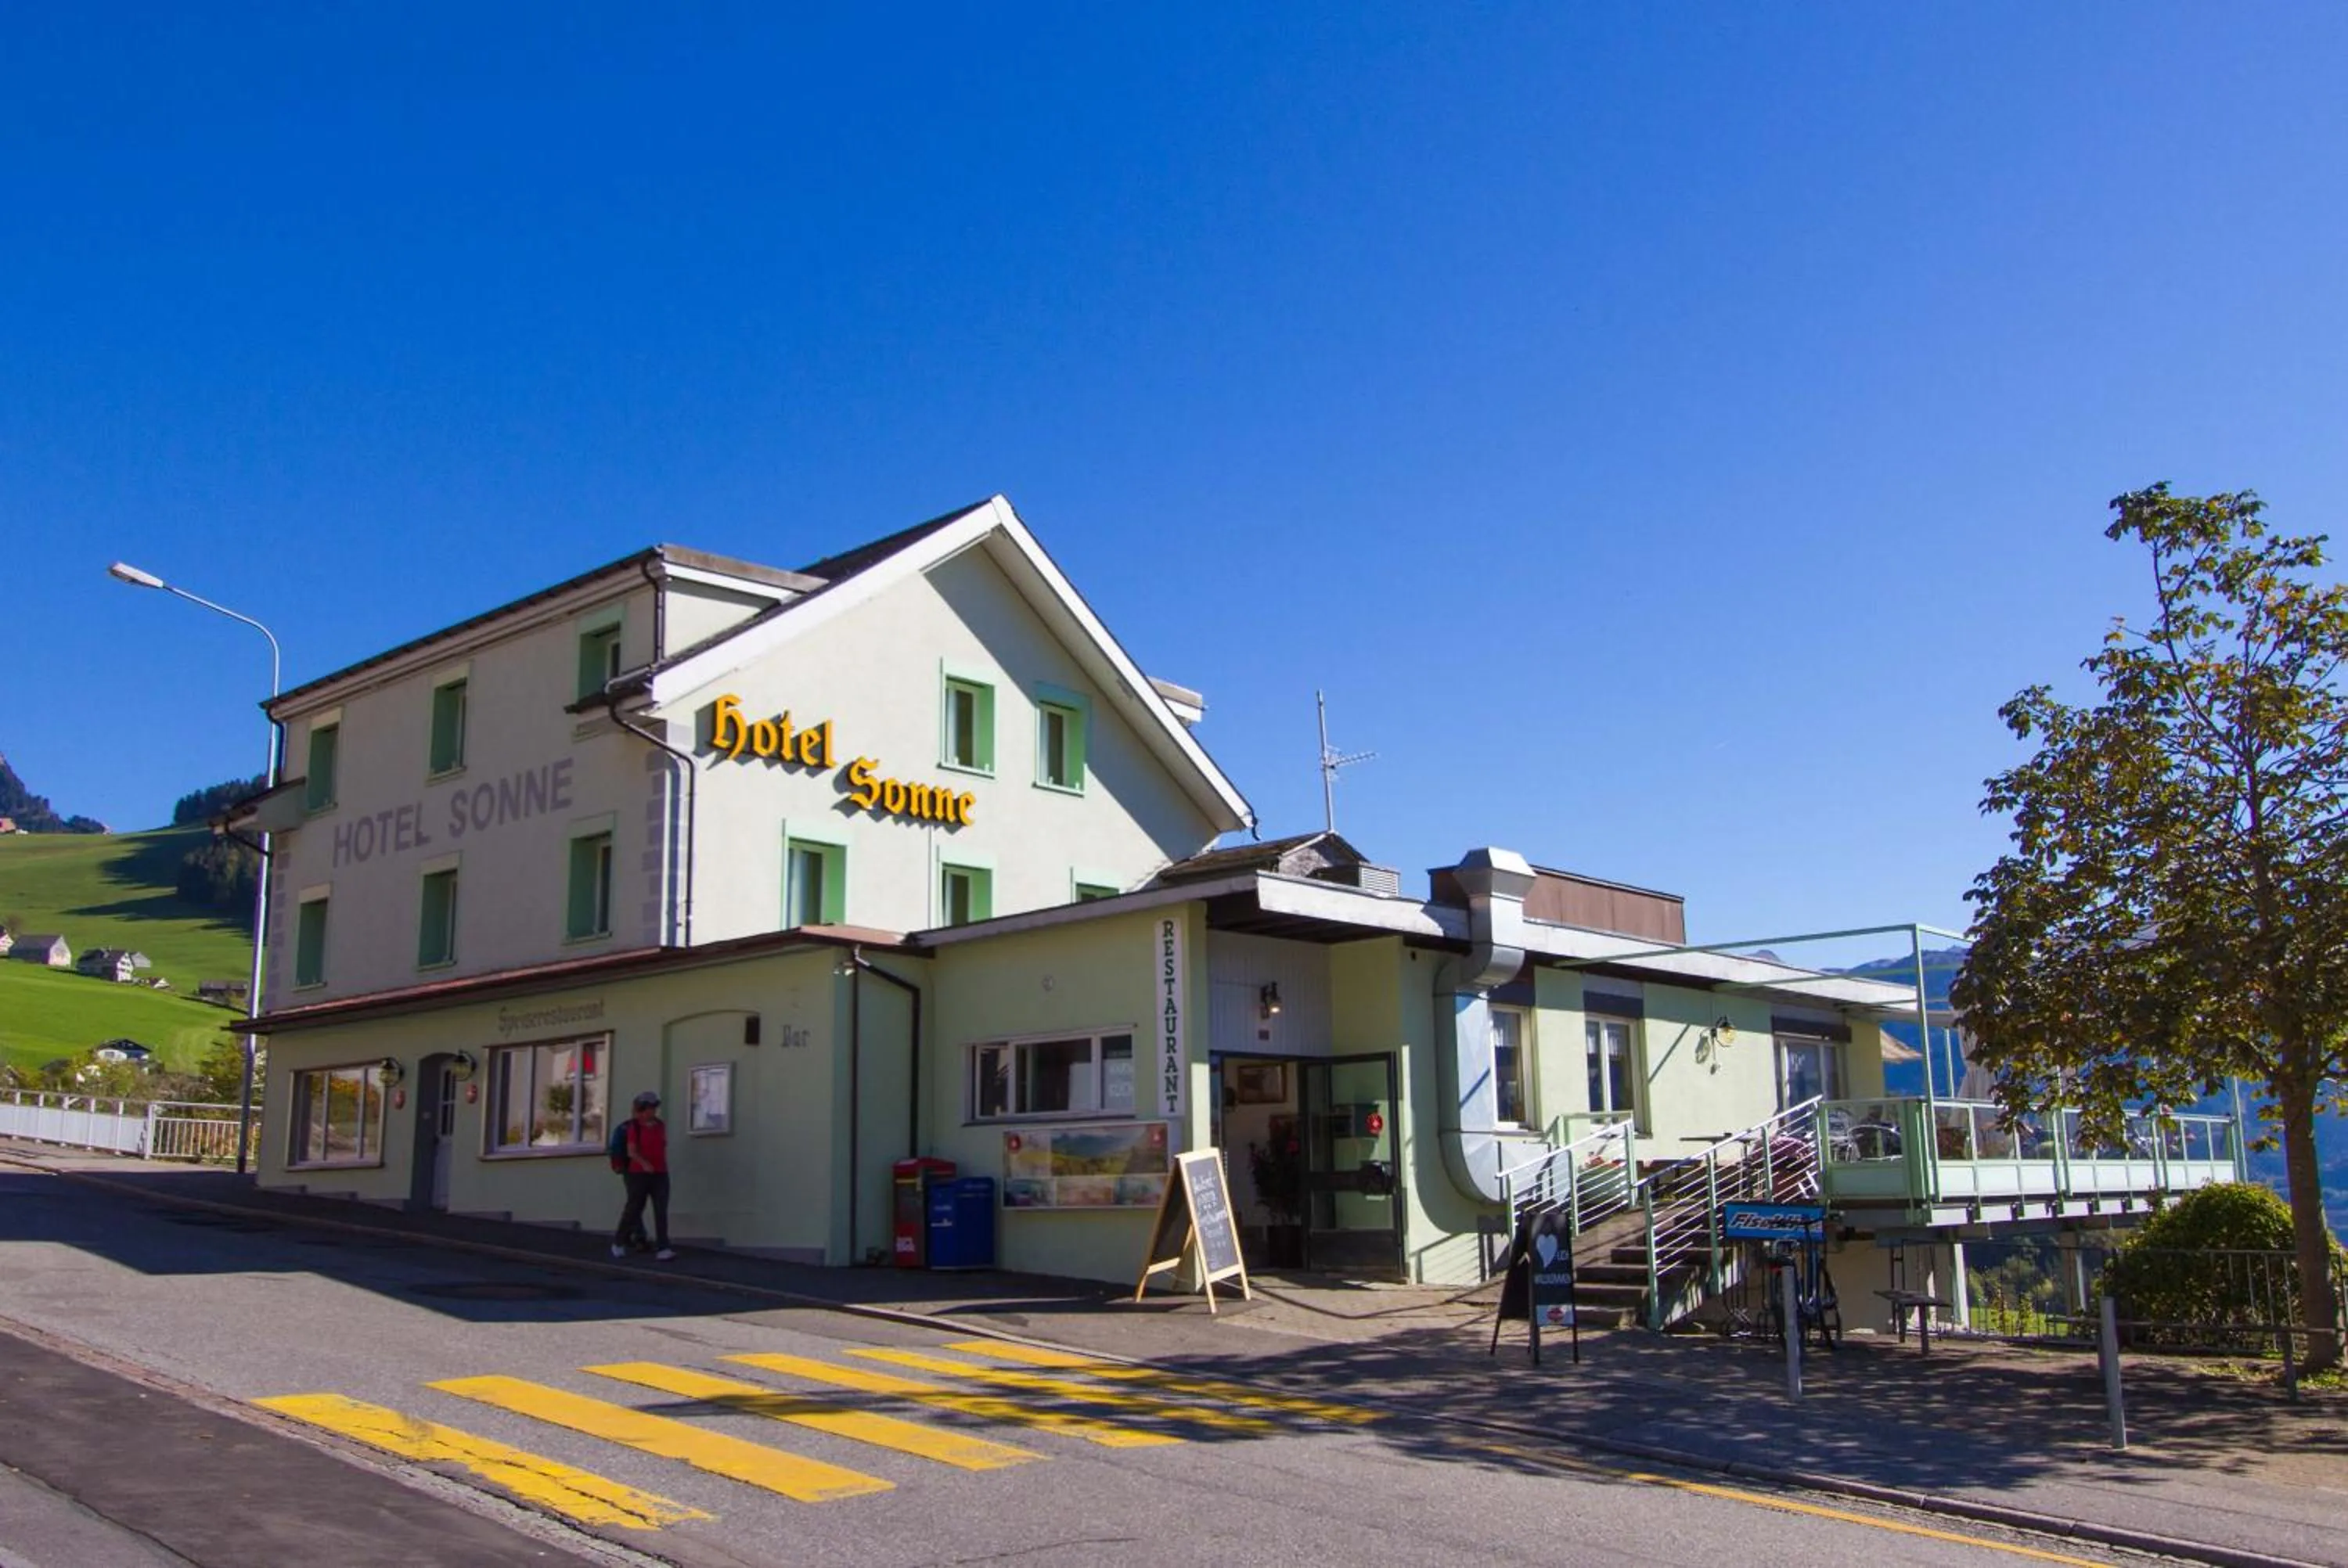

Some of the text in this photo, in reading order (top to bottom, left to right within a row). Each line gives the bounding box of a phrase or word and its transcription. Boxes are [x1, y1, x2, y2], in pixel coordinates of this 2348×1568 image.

[333, 758, 574, 868] HOTEL SONNE
[711, 692, 978, 827] Hotel Sonne
[1161, 919, 1179, 1113] RESTAURANT
